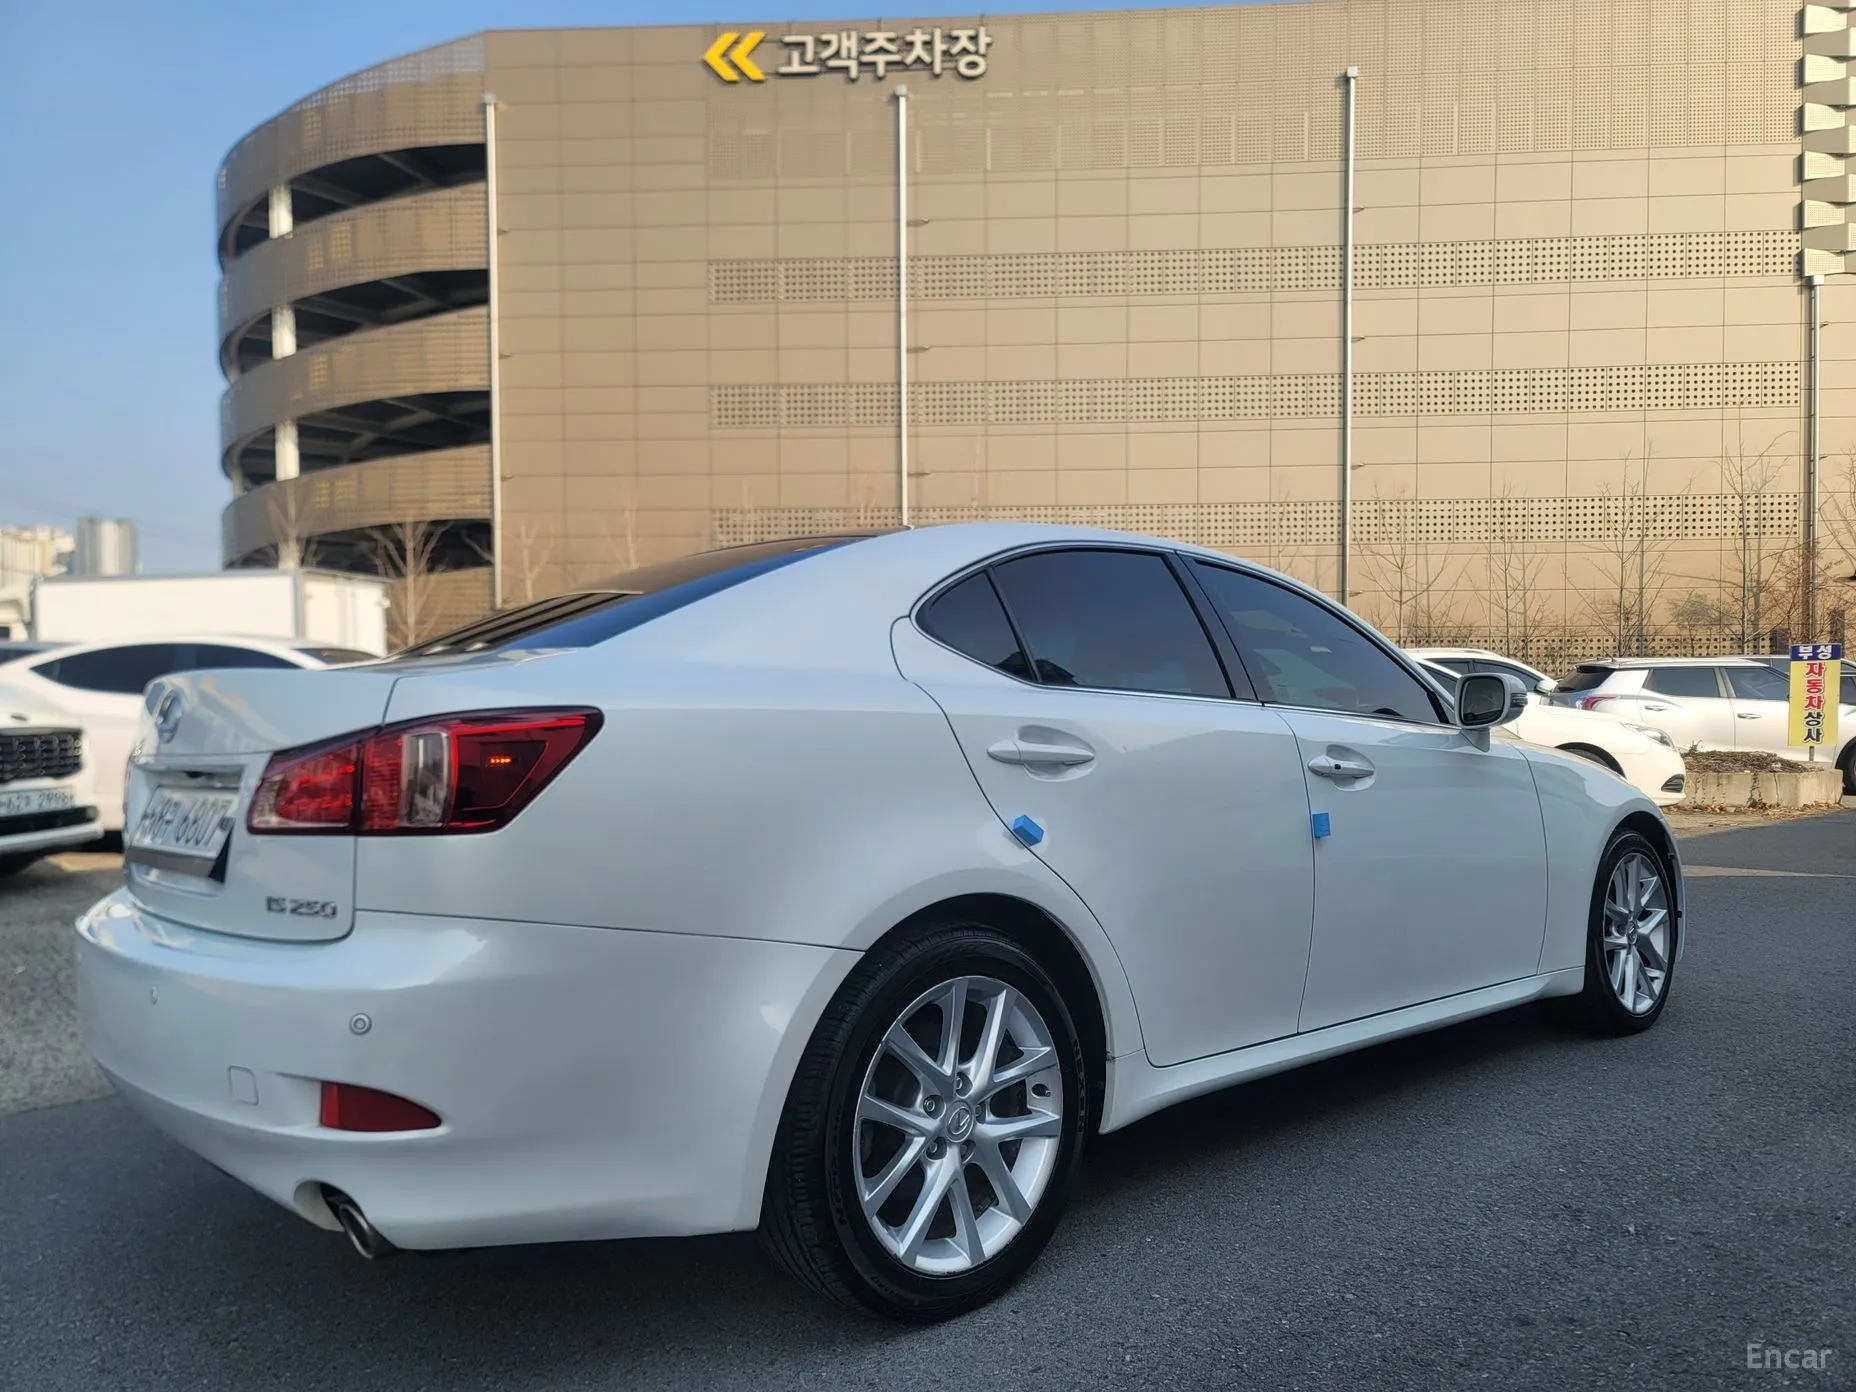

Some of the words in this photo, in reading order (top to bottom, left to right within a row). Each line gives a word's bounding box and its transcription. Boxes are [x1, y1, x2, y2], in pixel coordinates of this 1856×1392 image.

[776, 26, 992, 81] 고객주차장
[1798, 645, 1832, 660] 부성
[1803, 662, 1825, 743] 자동차상사
[289, 898, 338, 921] 250
